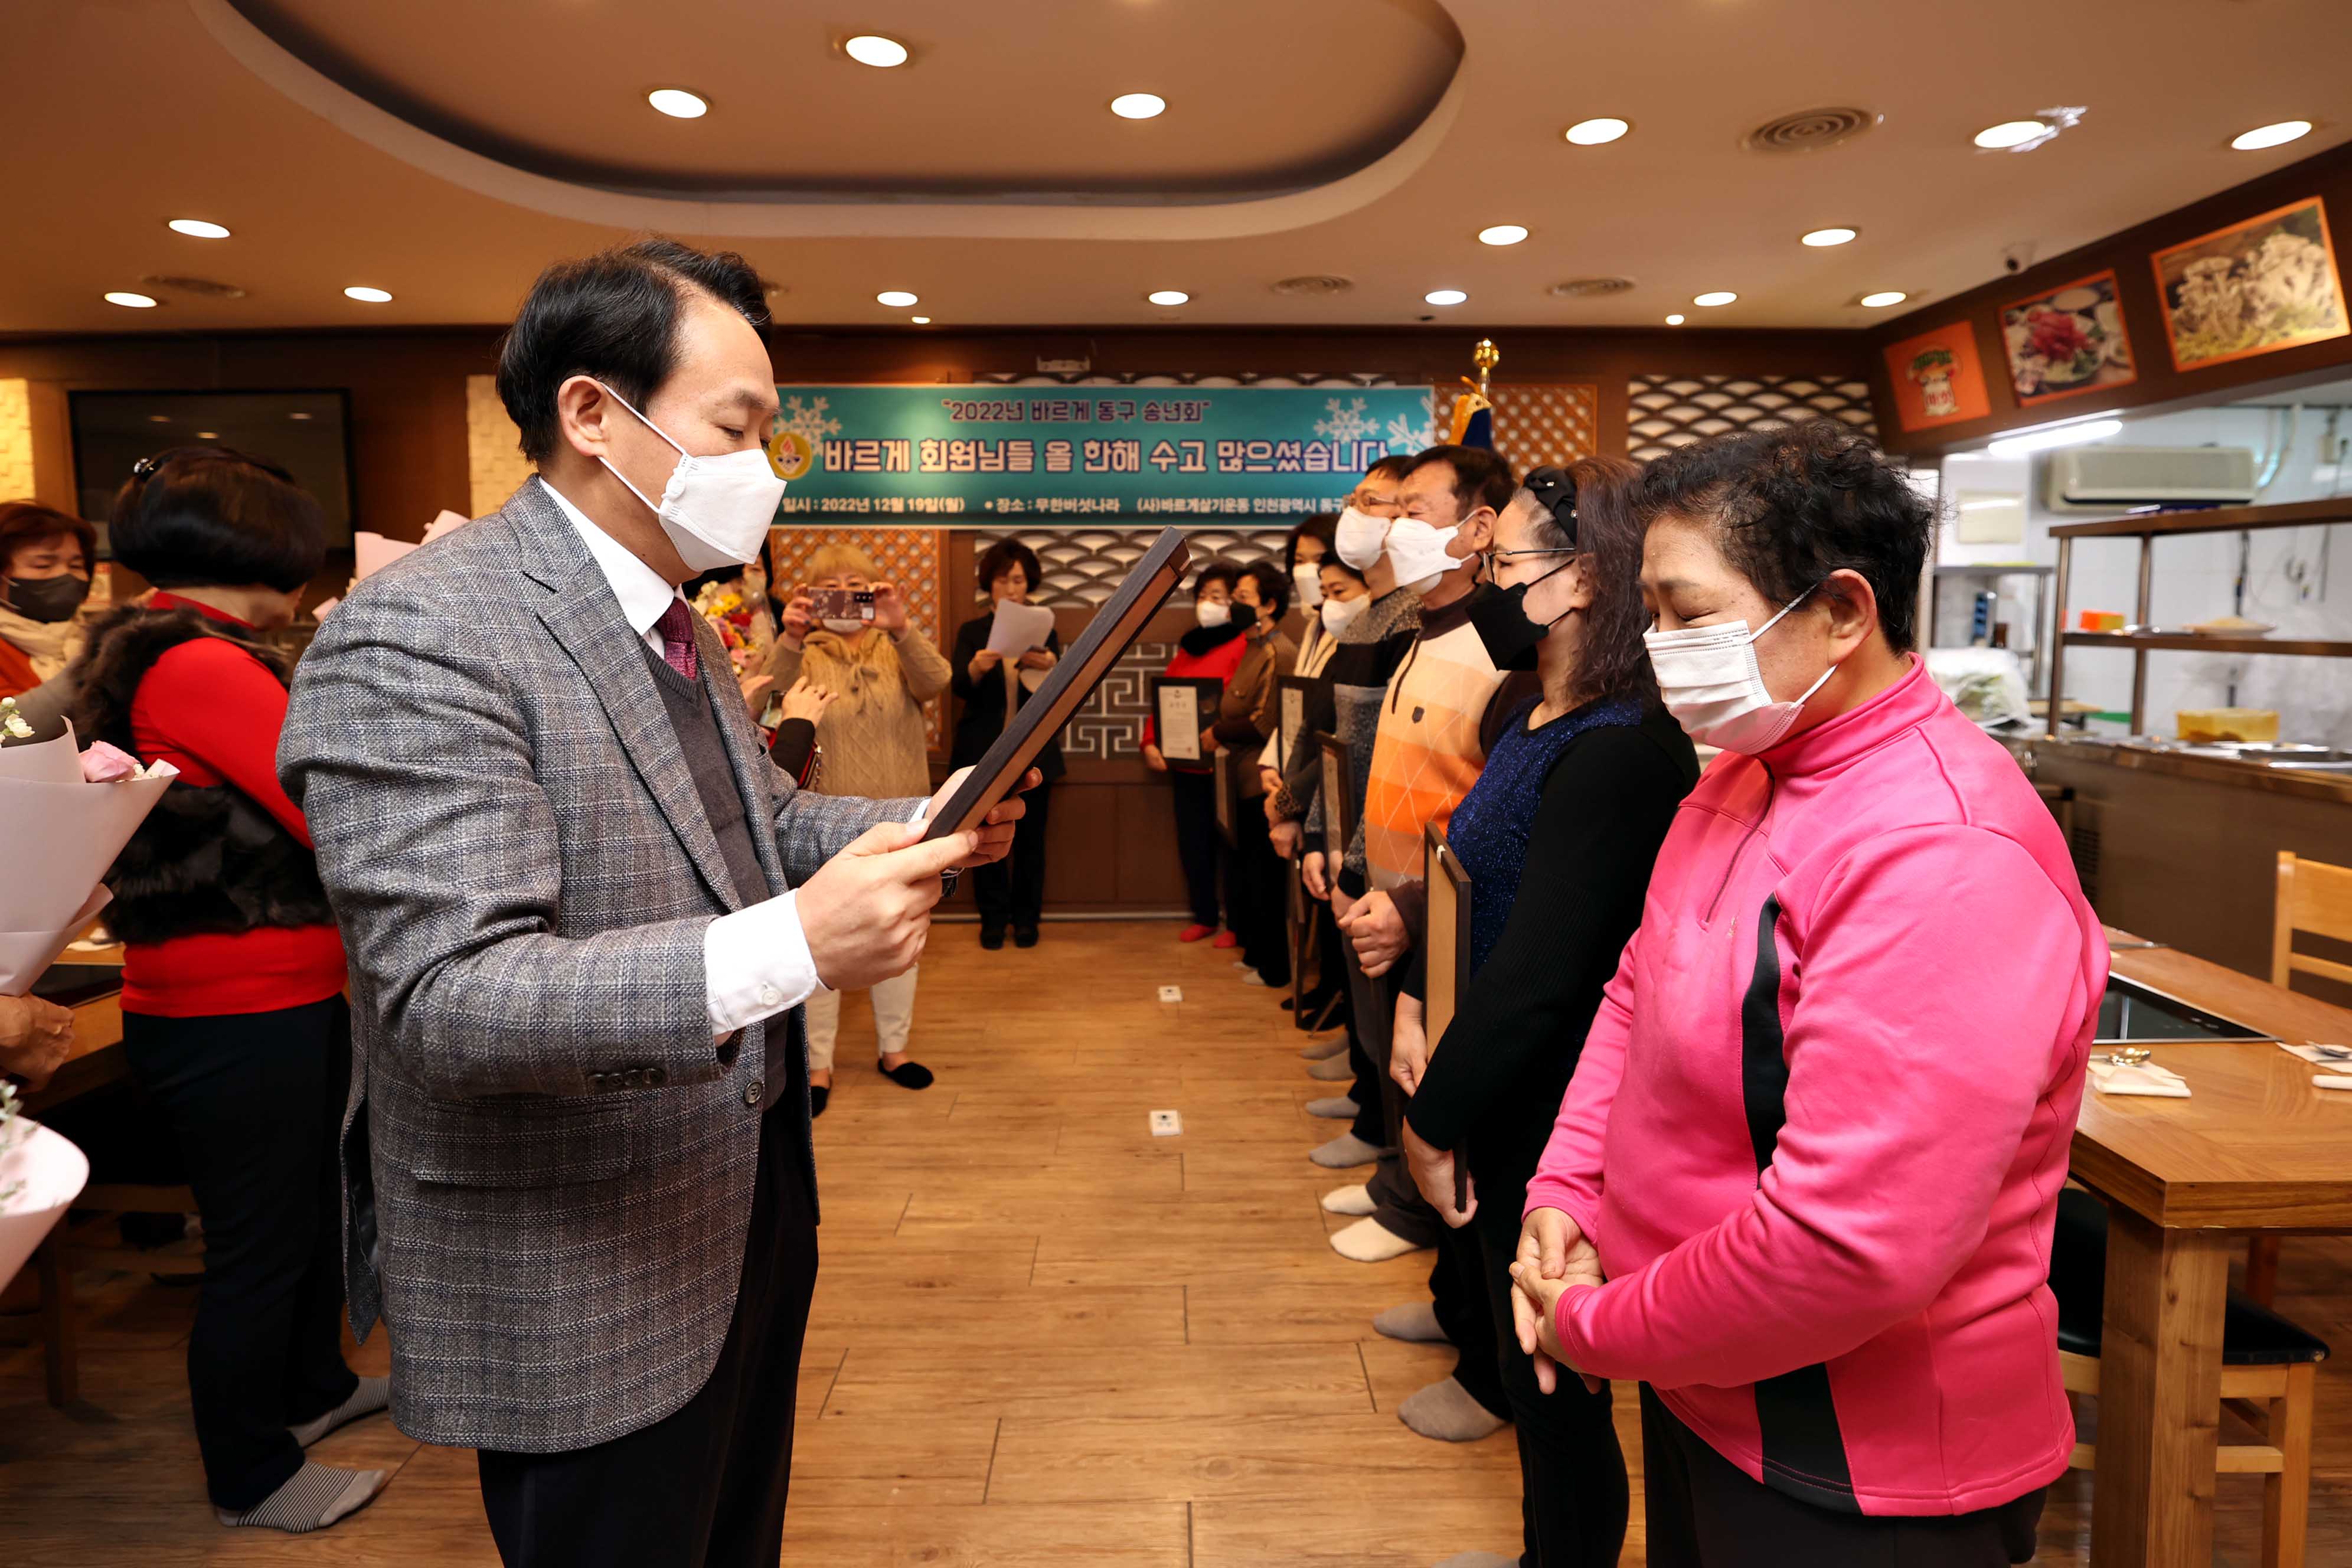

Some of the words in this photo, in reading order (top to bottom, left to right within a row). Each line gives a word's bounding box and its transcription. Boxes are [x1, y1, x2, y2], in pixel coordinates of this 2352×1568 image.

[1031, 400, 1090, 422] 바르게
[1097, 400, 1136, 422] 동구
[825, 440, 910, 472] 바르게
[919, 439, 1034, 472] 회원님들
[1045, 440, 1073, 472] 올
[1083, 440, 1140, 472] 한해
[1149, 440, 1207, 472] 수고
[782, 497, 811, 513] 일시
[821, 497, 870, 512] 2022년
[873, 497, 904, 512] 12월
[996, 498, 1025, 512] 장소
[1035, 498, 1121, 512] 무한버섯나라
